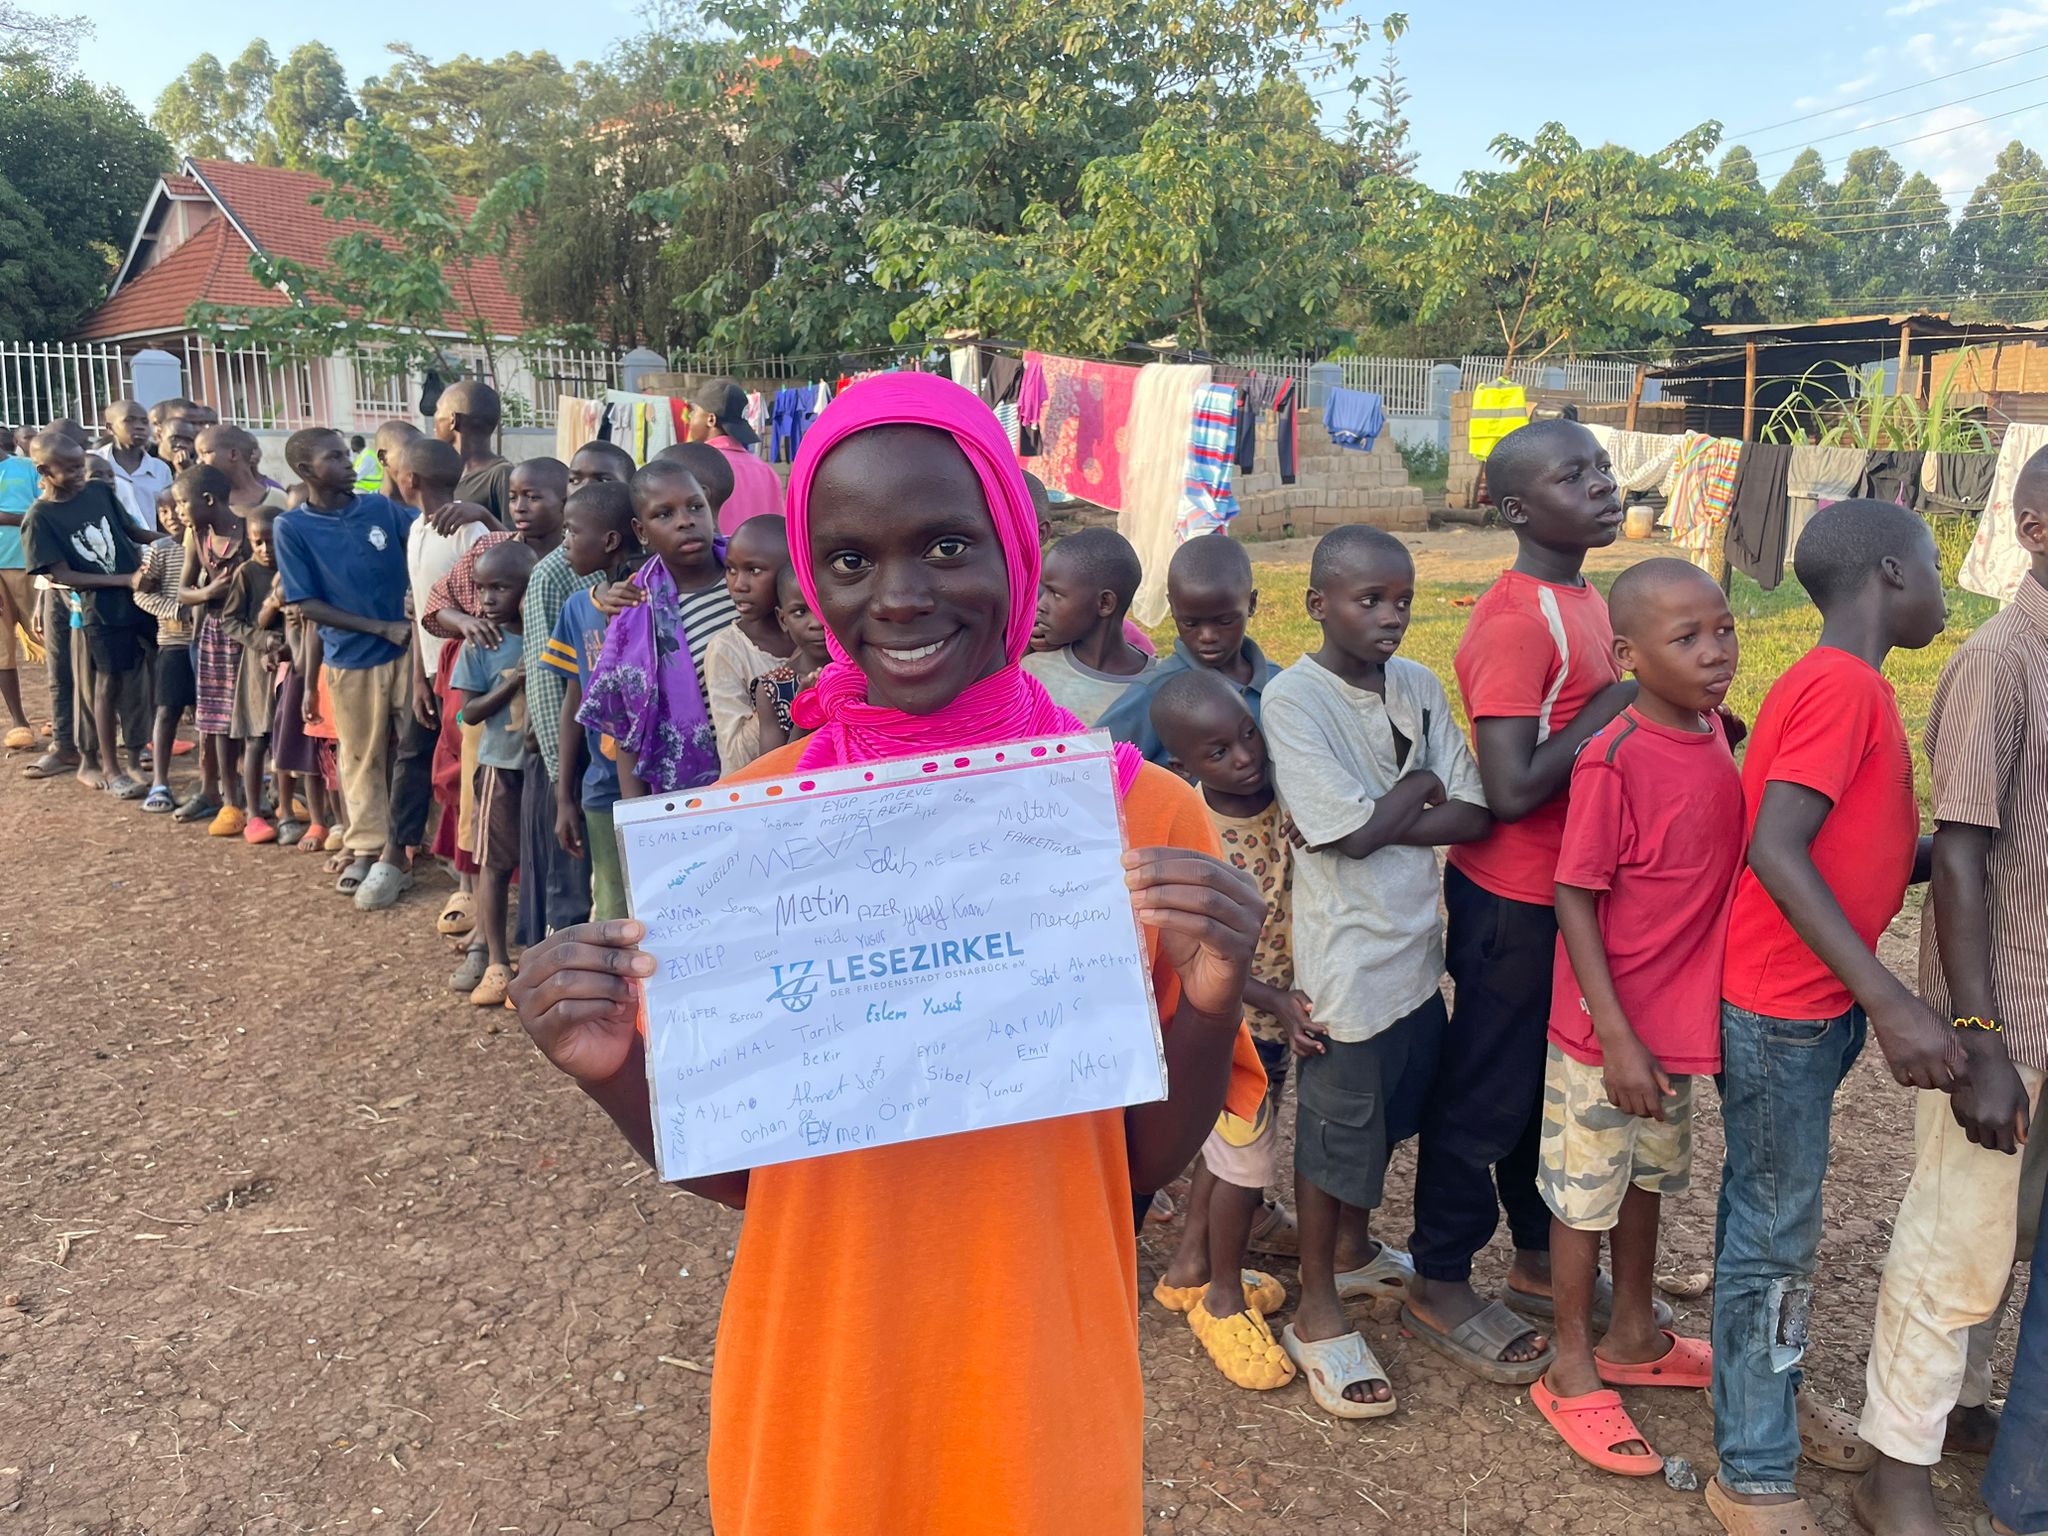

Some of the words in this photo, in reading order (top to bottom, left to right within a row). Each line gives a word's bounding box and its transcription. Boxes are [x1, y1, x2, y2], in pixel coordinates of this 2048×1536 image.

[775, 885, 849, 936] Metin
[857, 898, 901, 922] AZER
[665, 944, 726, 980] ZEYNEP
[827, 931, 1025, 985] LESEZIRKEL
[830, 987, 851, 998] DER
[856, 973, 941, 993] FRIEDENSSTADT
[944, 962, 1009, 979] OSNABRÜCK
[866, 1000, 907, 1024] Eslem
[922, 991, 963, 1016] Yusuf
[1016, 1042, 1050, 1060] Emir
[786, 1073, 849, 1110] Ahmet
[925, 1065, 972, 1086] Sibel
[980, 1079, 1024, 1100] Yunus
[740, 1119, 788, 1144] Orhan
